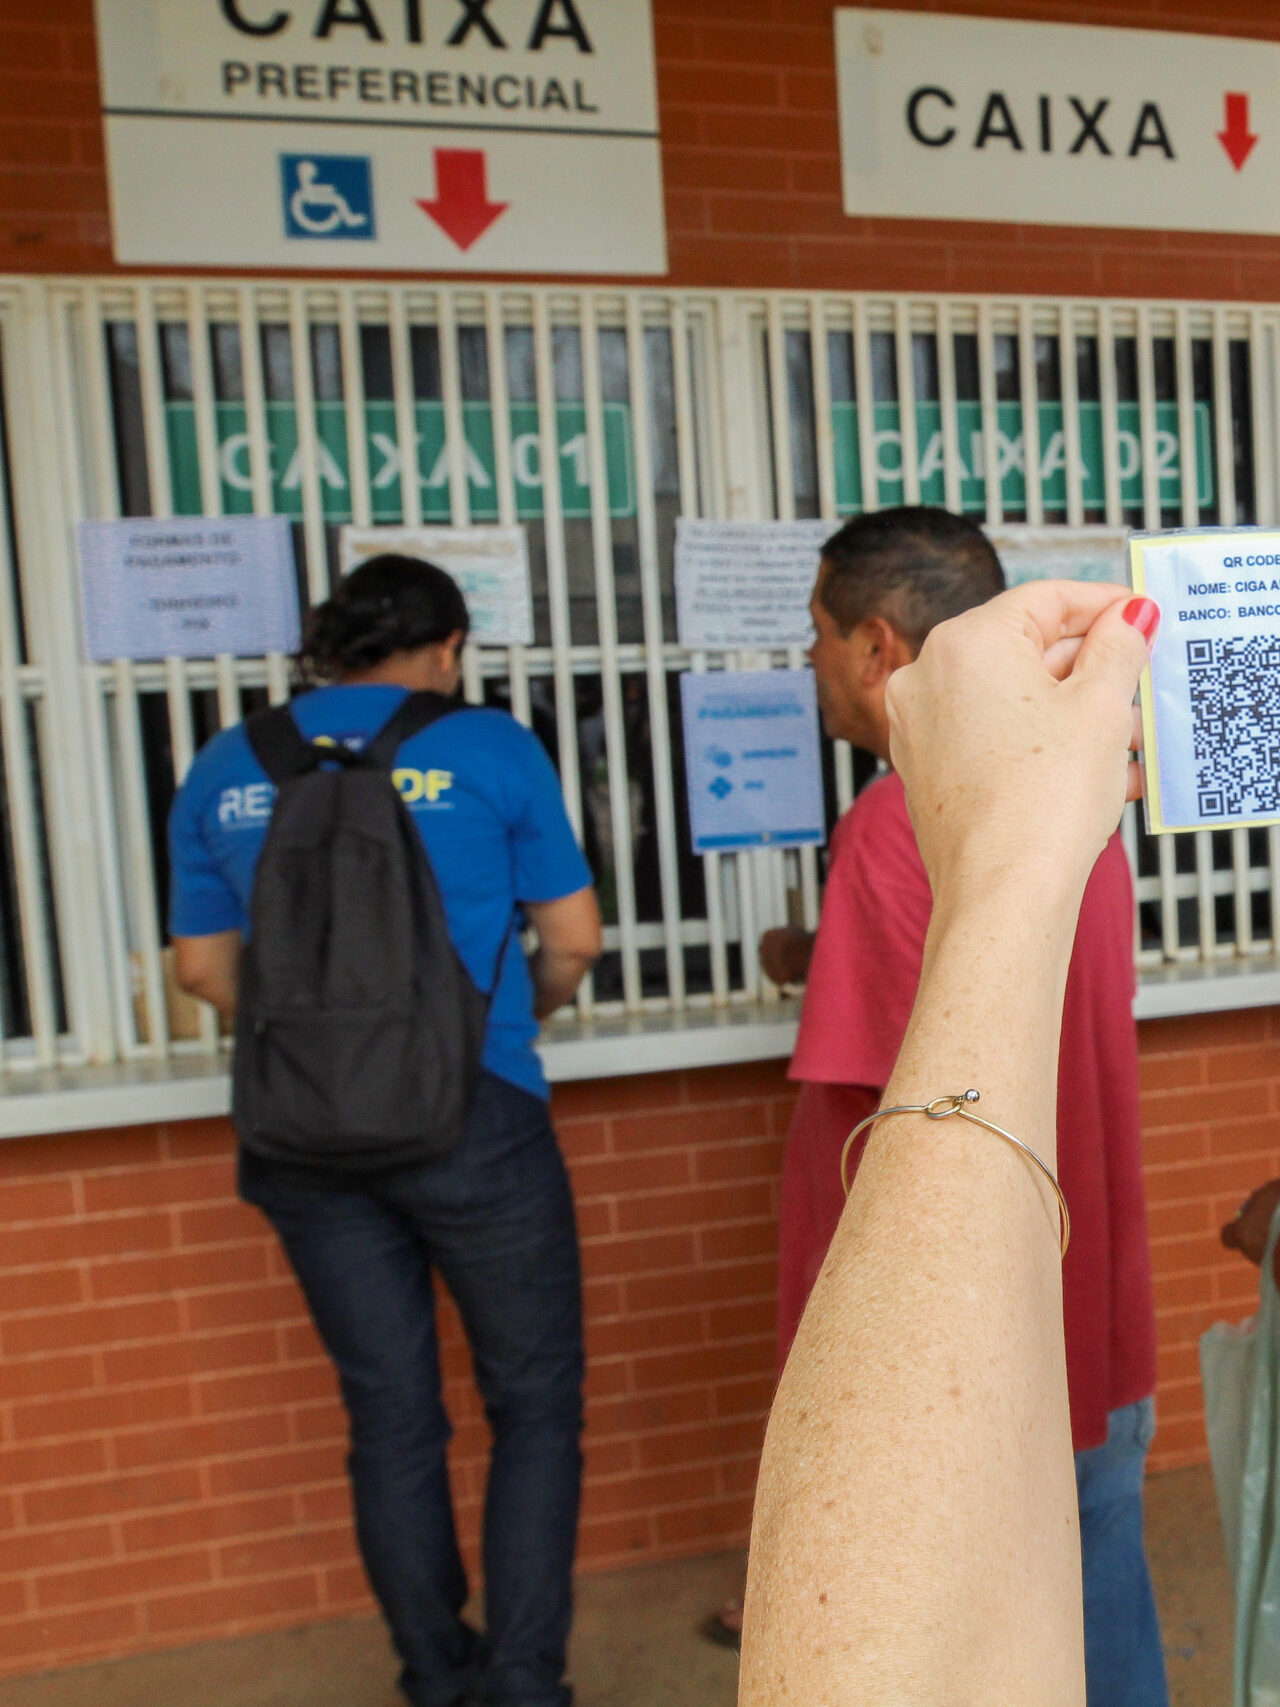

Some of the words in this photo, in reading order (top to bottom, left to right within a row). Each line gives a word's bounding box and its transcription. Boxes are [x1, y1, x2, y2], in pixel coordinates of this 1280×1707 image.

[221, 60, 600, 113] PREFERENCIAL
[906, 86, 1176, 160] CAIXA
[220, 431, 491, 489] CAXA
[1113, 429, 1181, 481] 02
[1188, 583, 1231, 595] NOME:
[1235, 580, 1267, 593] CIGA
[1223, 556, 1243, 568] QR
[1178, 608, 1231, 622] BANCO:
